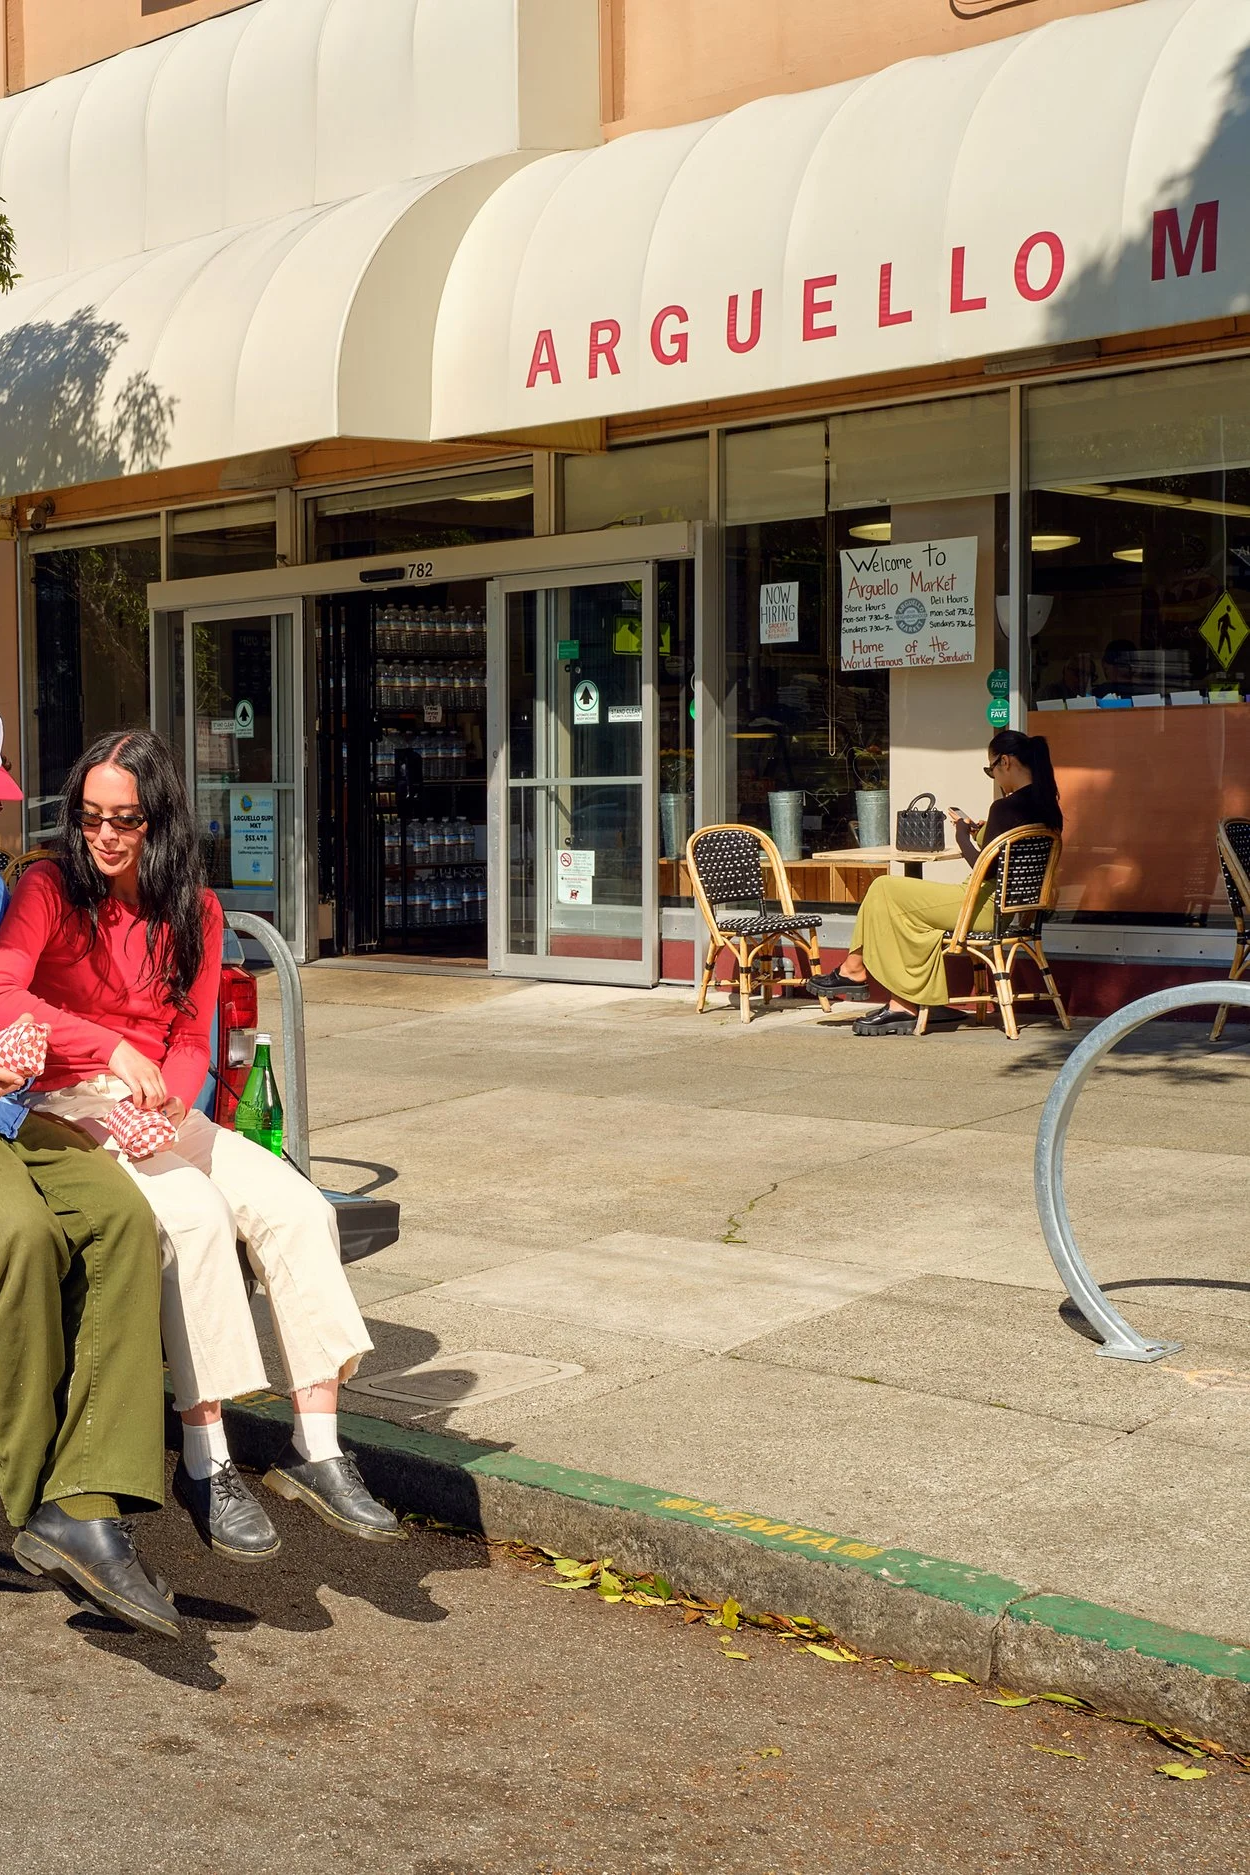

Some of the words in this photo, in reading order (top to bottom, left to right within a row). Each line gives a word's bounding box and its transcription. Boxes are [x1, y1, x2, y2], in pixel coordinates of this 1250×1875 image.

[525, 231, 1066, 389] ARGUELLO
[1151, 199, 1220, 282] M
[845, 548, 913, 573] Welcome
[408, 562, 433, 579] 782
[765, 585, 791, 605] NOW
[847, 576, 899, 600] Arguello
[844, 604, 863, 613] Store
[865, 603, 886, 611] Hours
[930, 595, 945, 605] Deli
[946, 594, 969, 604] Hours
[760, 604, 796, 624] HIRING
[852, 639, 885, 654] Home
[905, 640, 918, 653] of
[929, 636, 950, 653] the
[841, 655, 872, 669] World
[874, 655, 904, 669] Famous
[938, 651, 972, 664] Sandwich
[990, 681, 1008, 689] FAVE
[245, 834, 267, 842] $53,478
